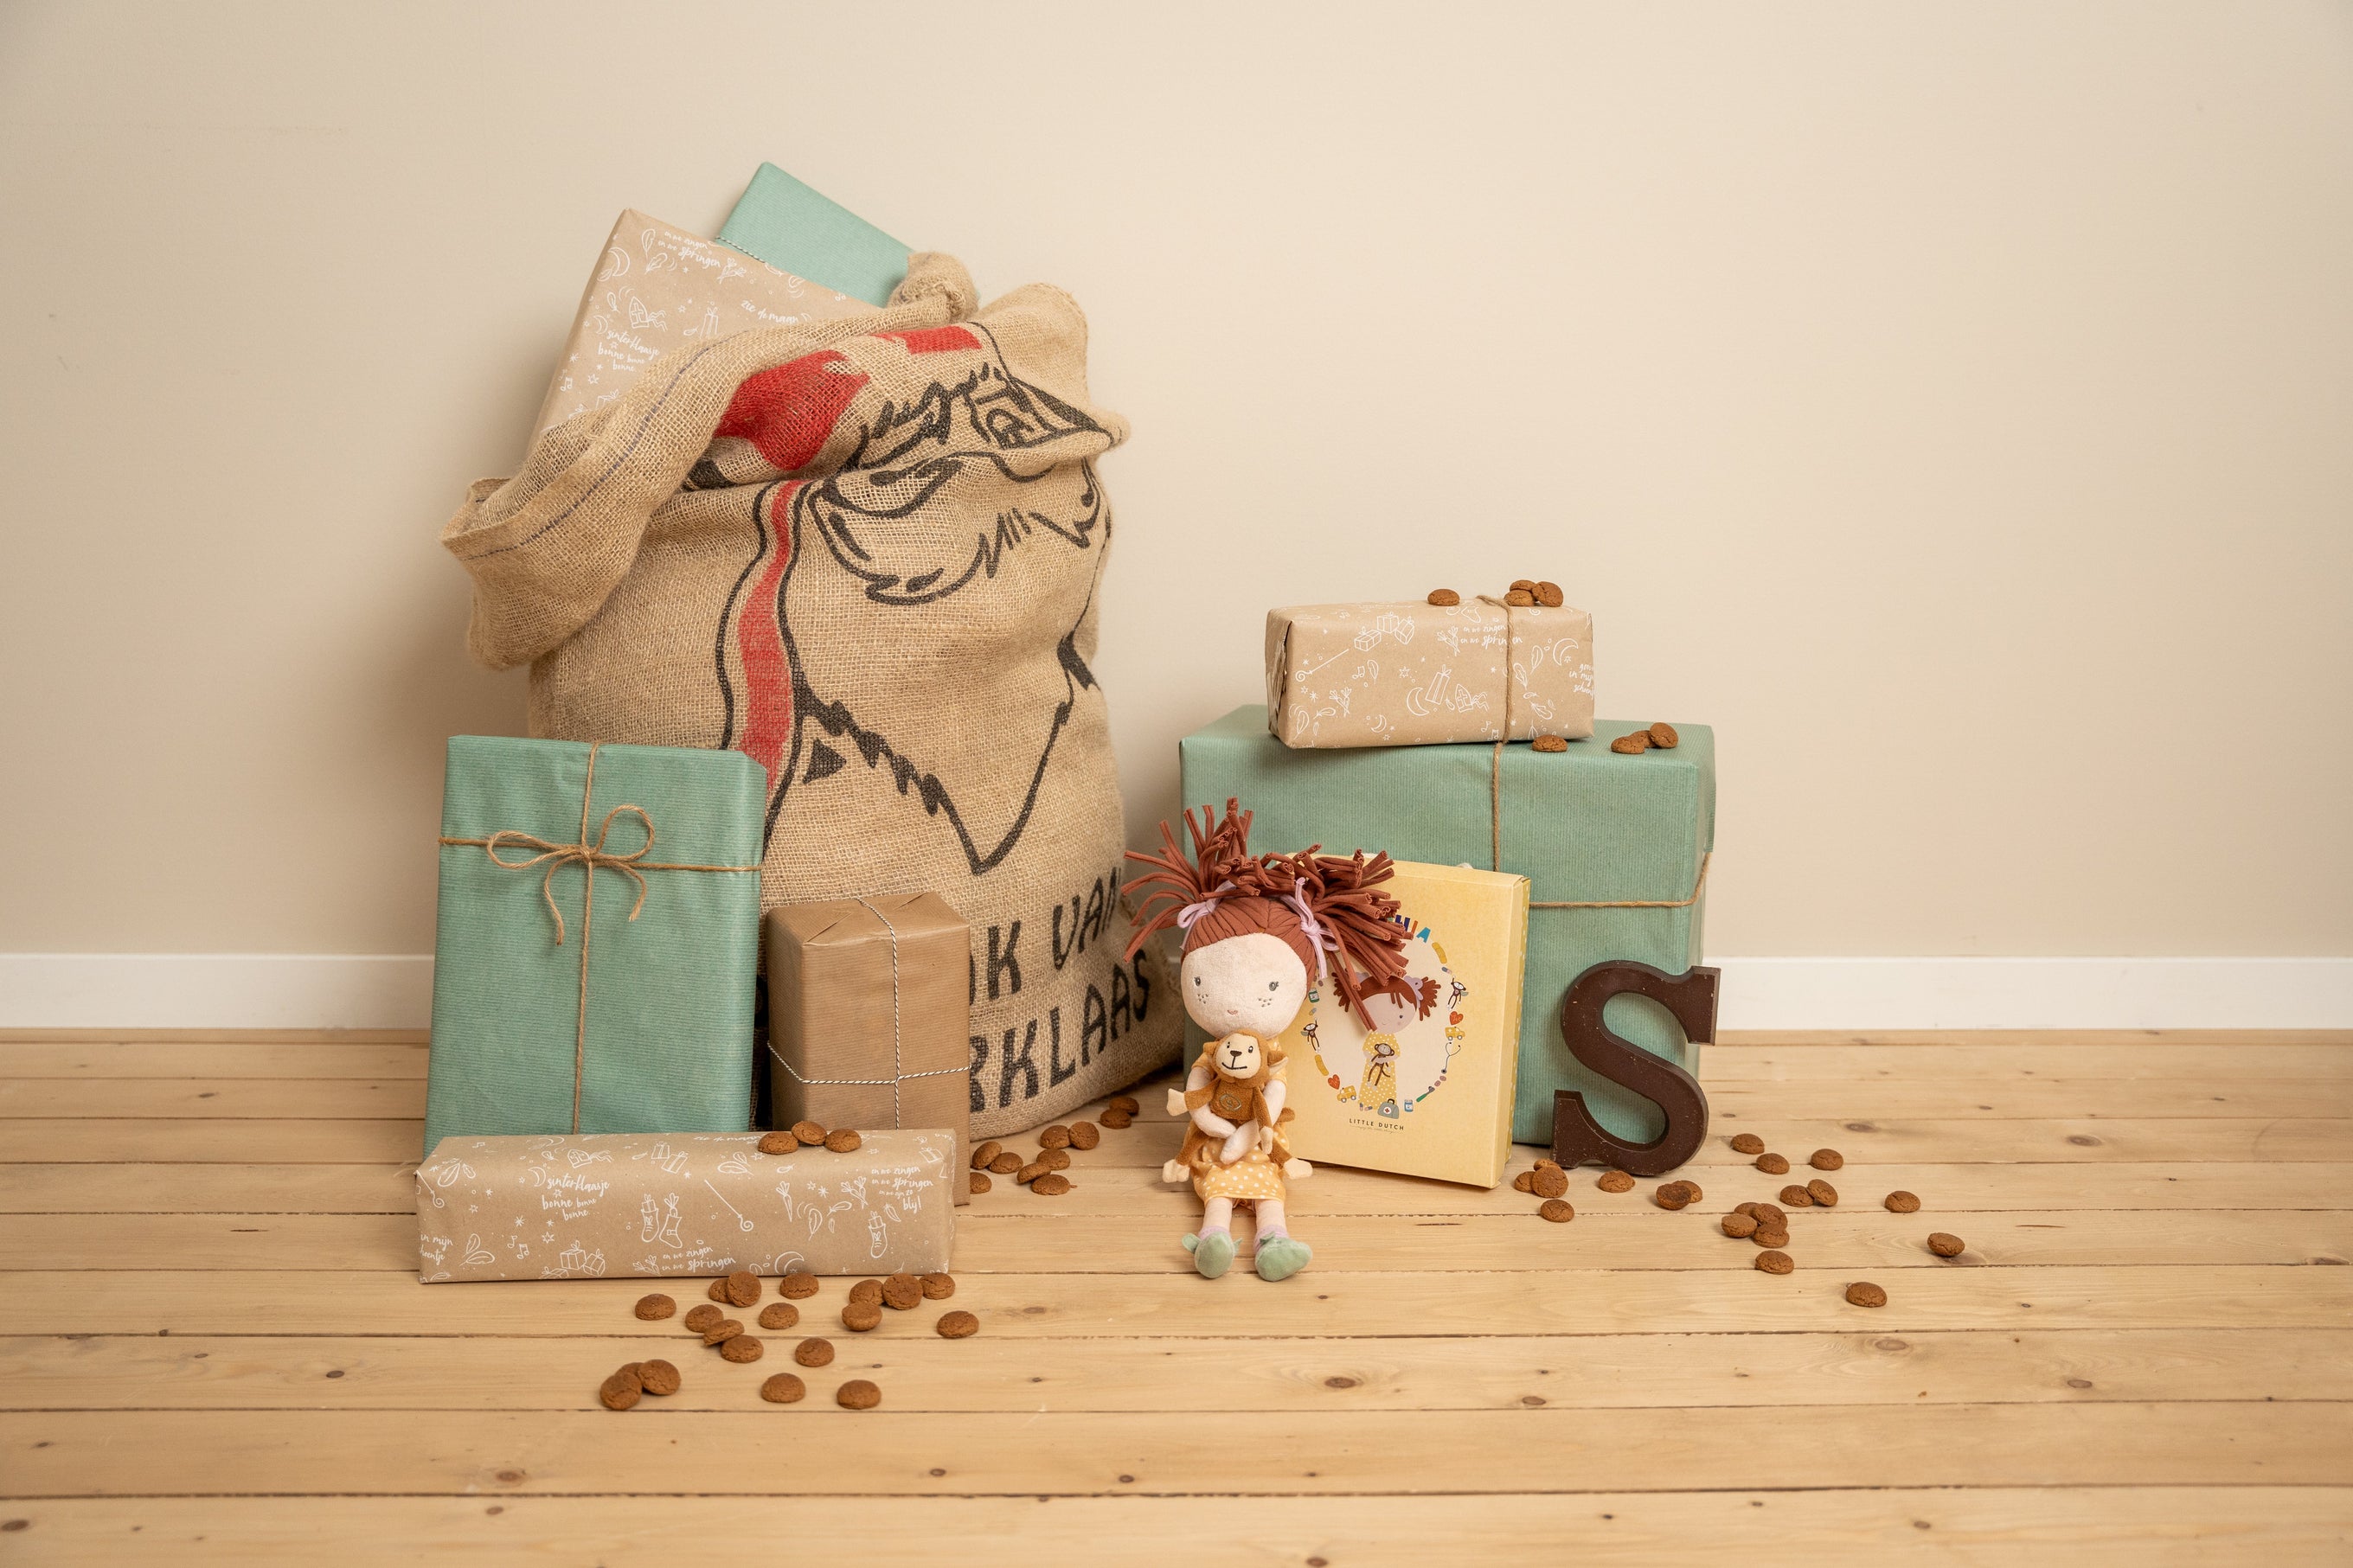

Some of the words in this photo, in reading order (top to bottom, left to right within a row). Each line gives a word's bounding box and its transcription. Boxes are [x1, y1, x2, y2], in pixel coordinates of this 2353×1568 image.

[677, 246, 721, 269] springen
[598, 342, 624, 360] bonne
[1481, 634, 1523, 650] sprinen
[1349, 1118, 1375, 1127] LITTLE
[1378, 1122, 1404, 1130] DUTCH
[547, 1172, 610, 1198] sinterklaasje
[892, 1176, 933, 1192] springen
[542, 1194, 574, 1210] bonne
[576, 1197, 597, 1208] bonne
[420, 1244, 446, 1266] hoentje
[686, 1246, 714, 1259] zingen
[688, 1257, 736, 1273] springen
